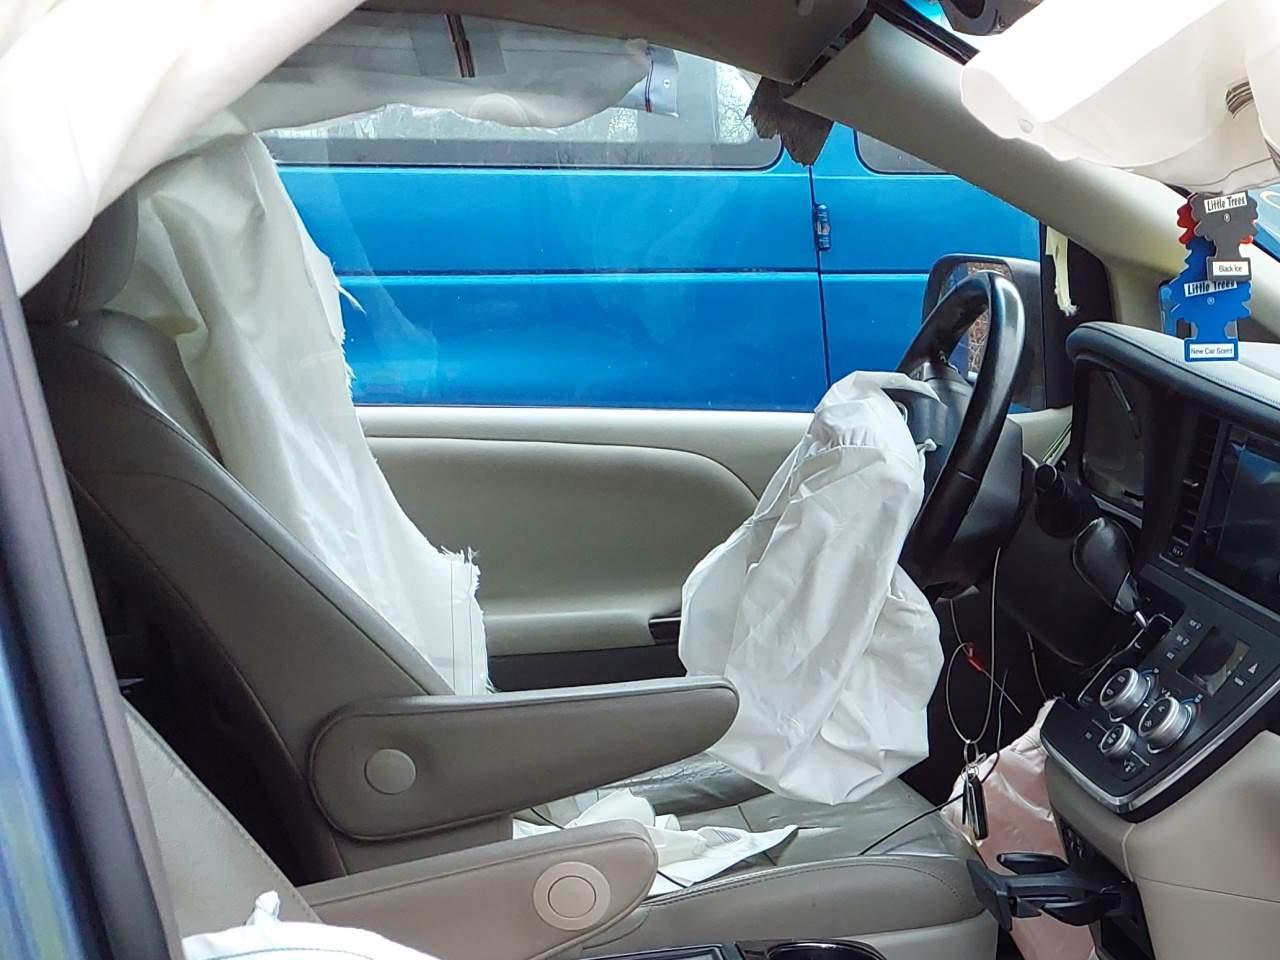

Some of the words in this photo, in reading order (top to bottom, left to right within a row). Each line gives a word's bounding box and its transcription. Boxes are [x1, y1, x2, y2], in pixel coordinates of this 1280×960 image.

[1207, 199, 1226, 212] Little
[1227, 195, 1245, 208] Trees
[1187, 282, 1210, 295] Little
[1213, 280, 1236, 292] Trees
[1191, 345, 1203, 355] New
[1204, 345, 1215, 355] Car
[1216, 345, 1233, 355] Scent
